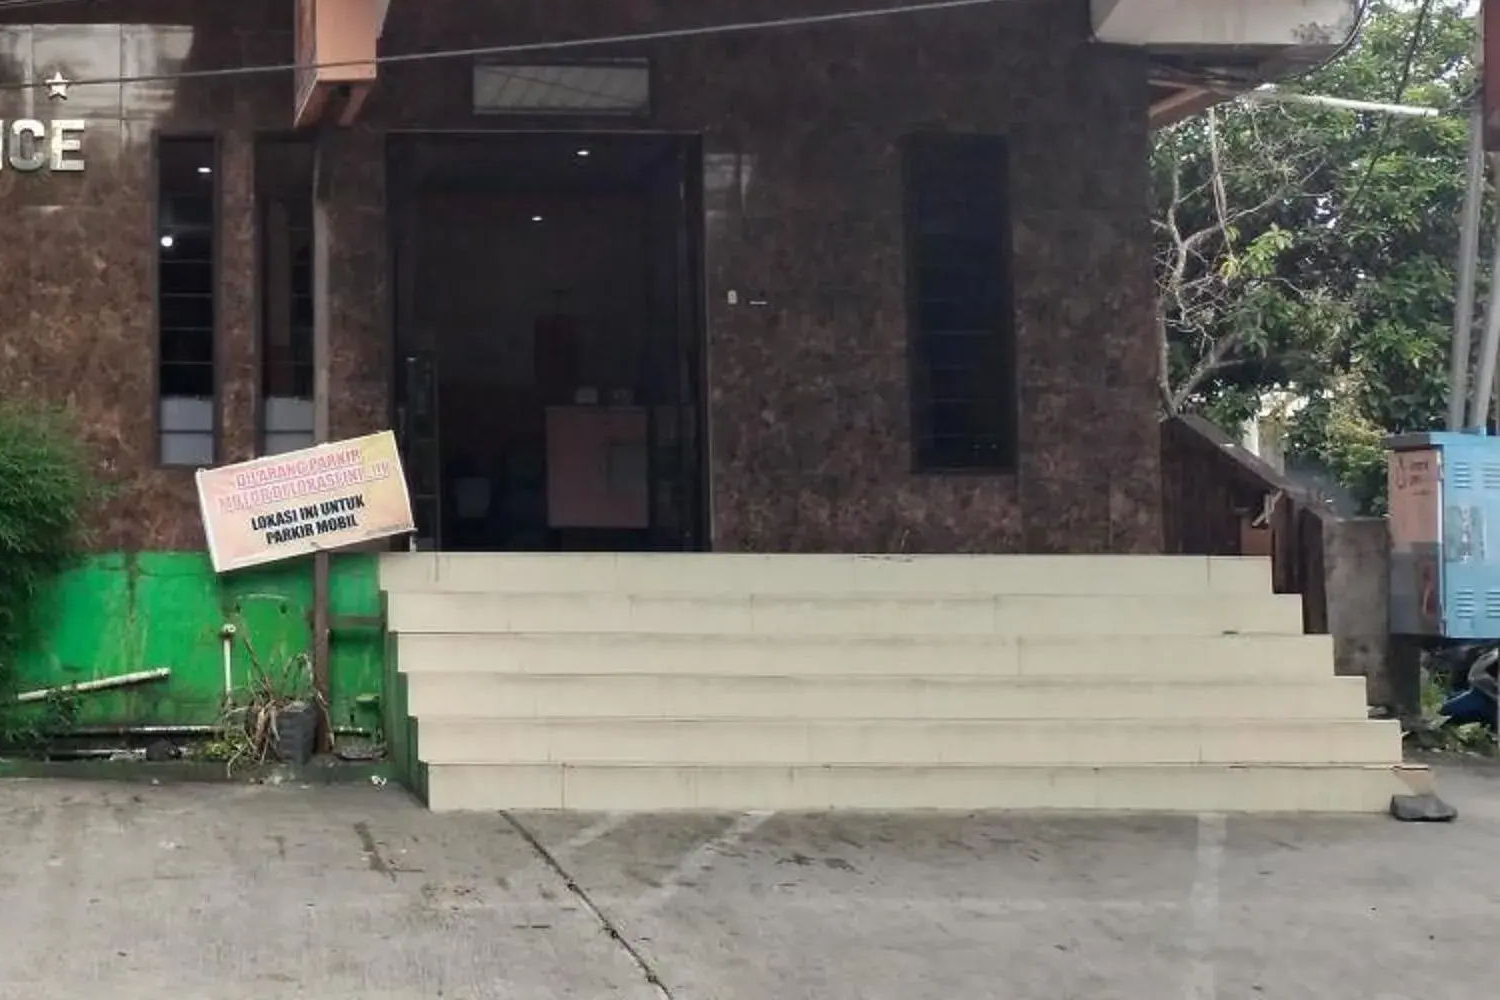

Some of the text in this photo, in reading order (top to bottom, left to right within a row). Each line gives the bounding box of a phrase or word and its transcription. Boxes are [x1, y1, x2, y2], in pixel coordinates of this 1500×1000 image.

[251, 494, 365, 531] LOKASI INI UNTUK
[266, 523, 315, 544] PARKIR
[316, 514, 359, 534] MOBIL
